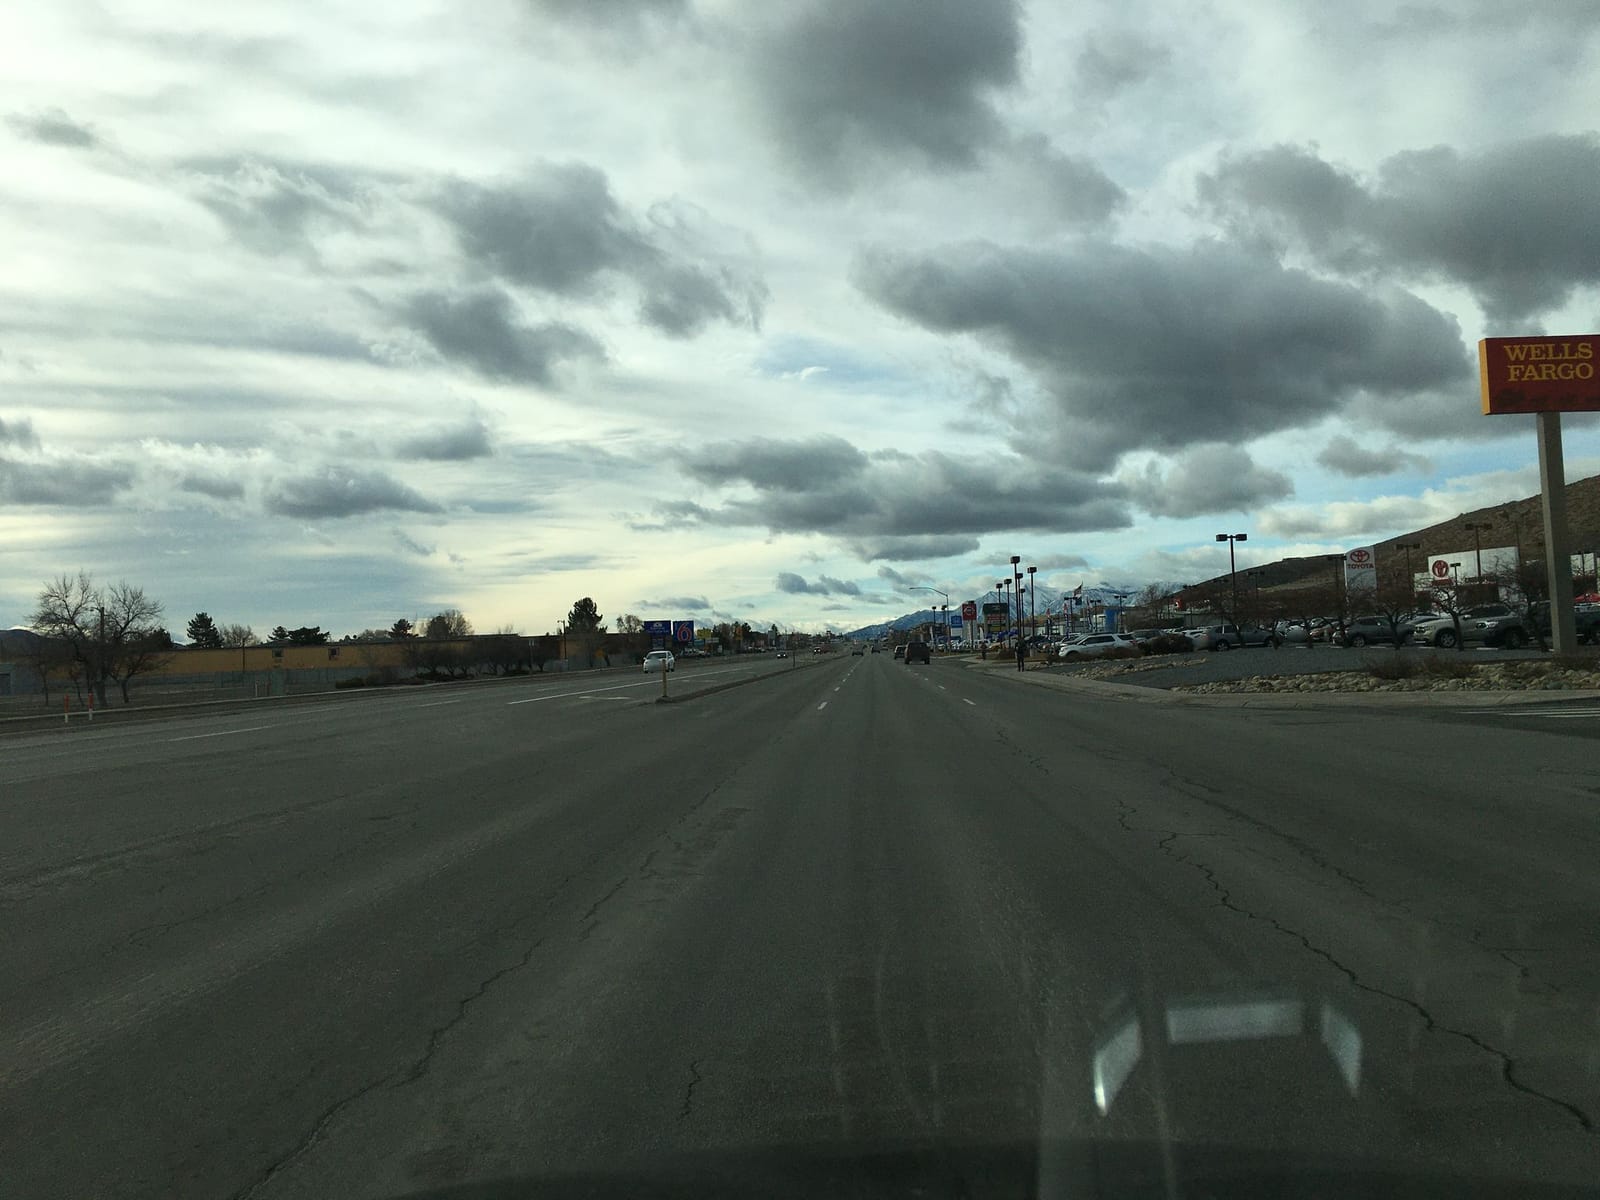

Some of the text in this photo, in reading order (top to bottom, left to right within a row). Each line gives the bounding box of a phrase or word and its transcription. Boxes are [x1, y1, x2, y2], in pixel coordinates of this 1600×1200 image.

[1503, 342, 1593, 361] WELLS
[1507, 362, 1594, 382] FARGO
[677, 622, 692, 641] 6
